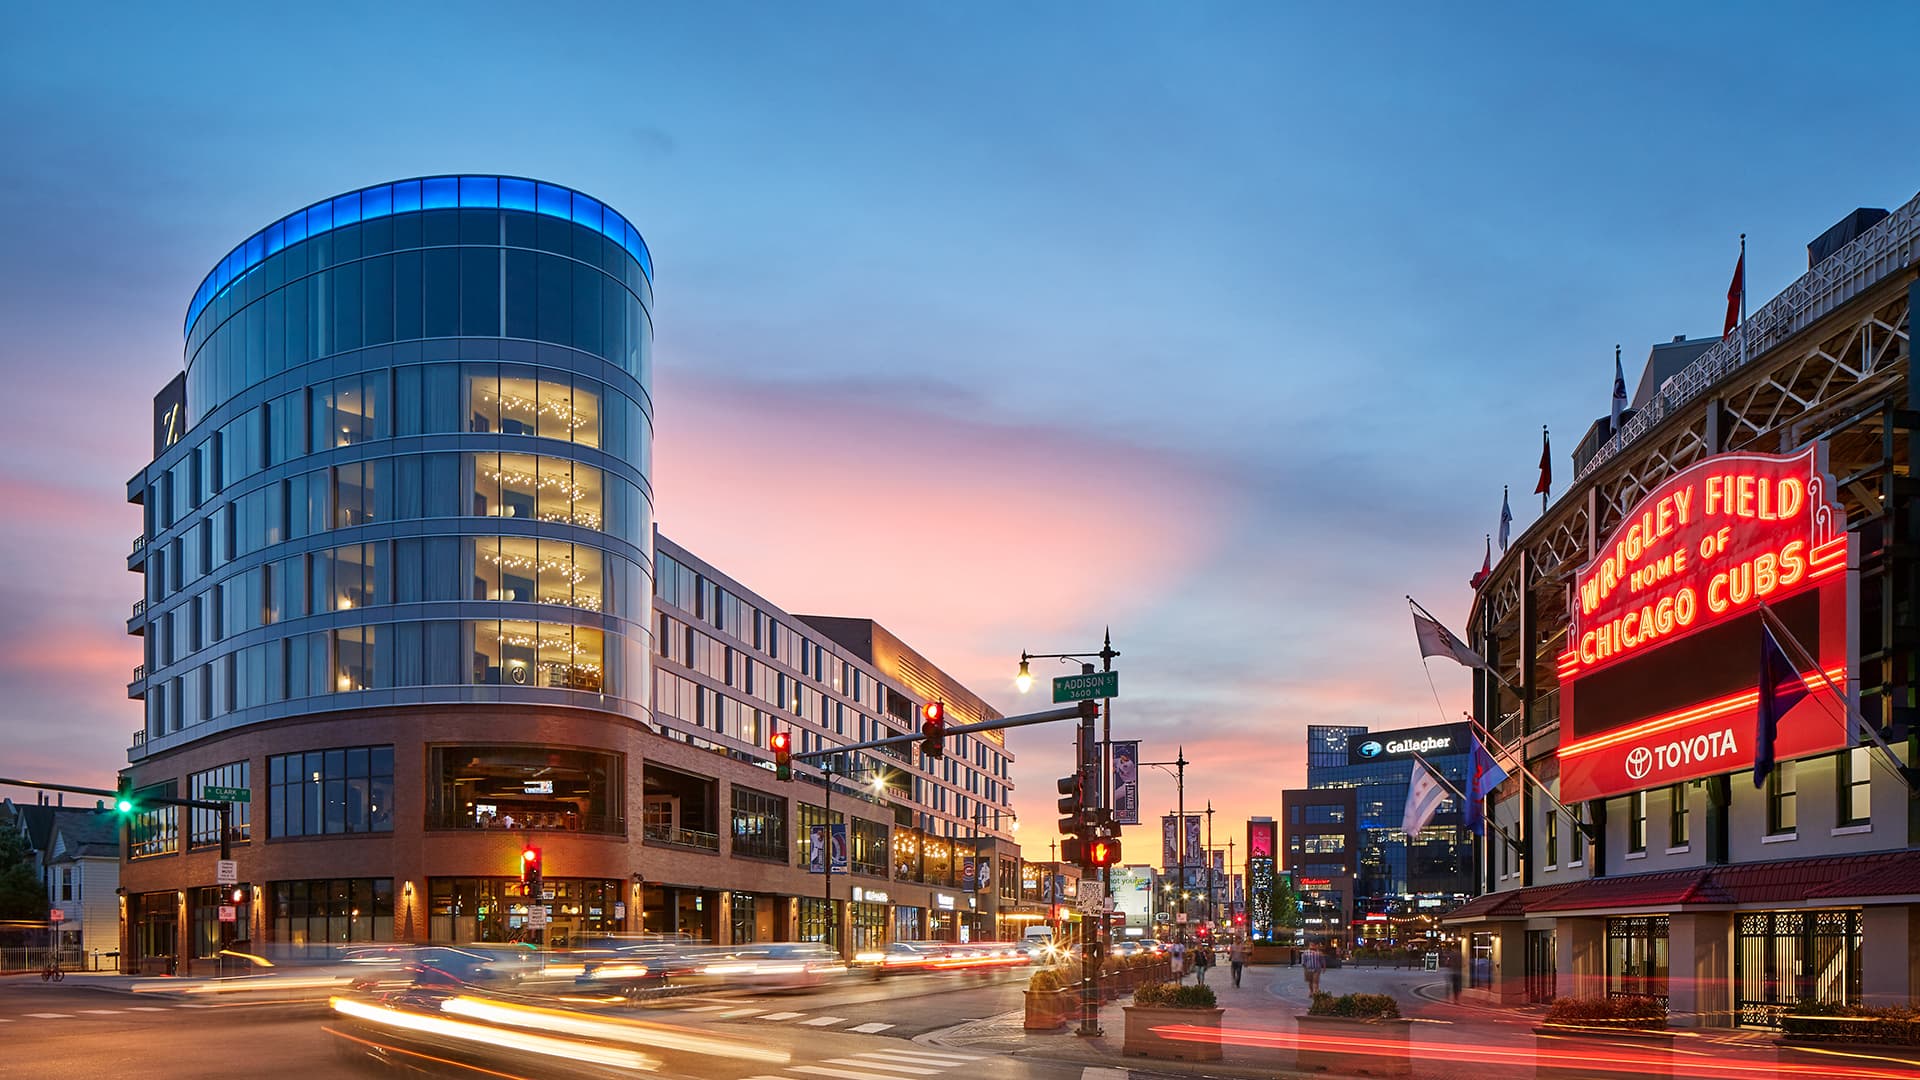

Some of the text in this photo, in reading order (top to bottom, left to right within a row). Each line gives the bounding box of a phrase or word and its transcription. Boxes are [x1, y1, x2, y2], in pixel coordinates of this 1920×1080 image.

[1580, 474, 1803, 615] WRIGLEY FIELD
[1630, 526, 1731, 593] HOME OF
[1580, 540, 1807, 665] CHICAGO CUBS
[1064, 676, 1105, 690] ADDISON
[1071, 689, 1091, 698] 3600
[1386, 736, 1451, 754] Gallagher
[1654, 728, 1738, 771] TOYOTA
[215, 788, 237, 796] CLARK
[1126, 786, 1135, 810] BRYANT
